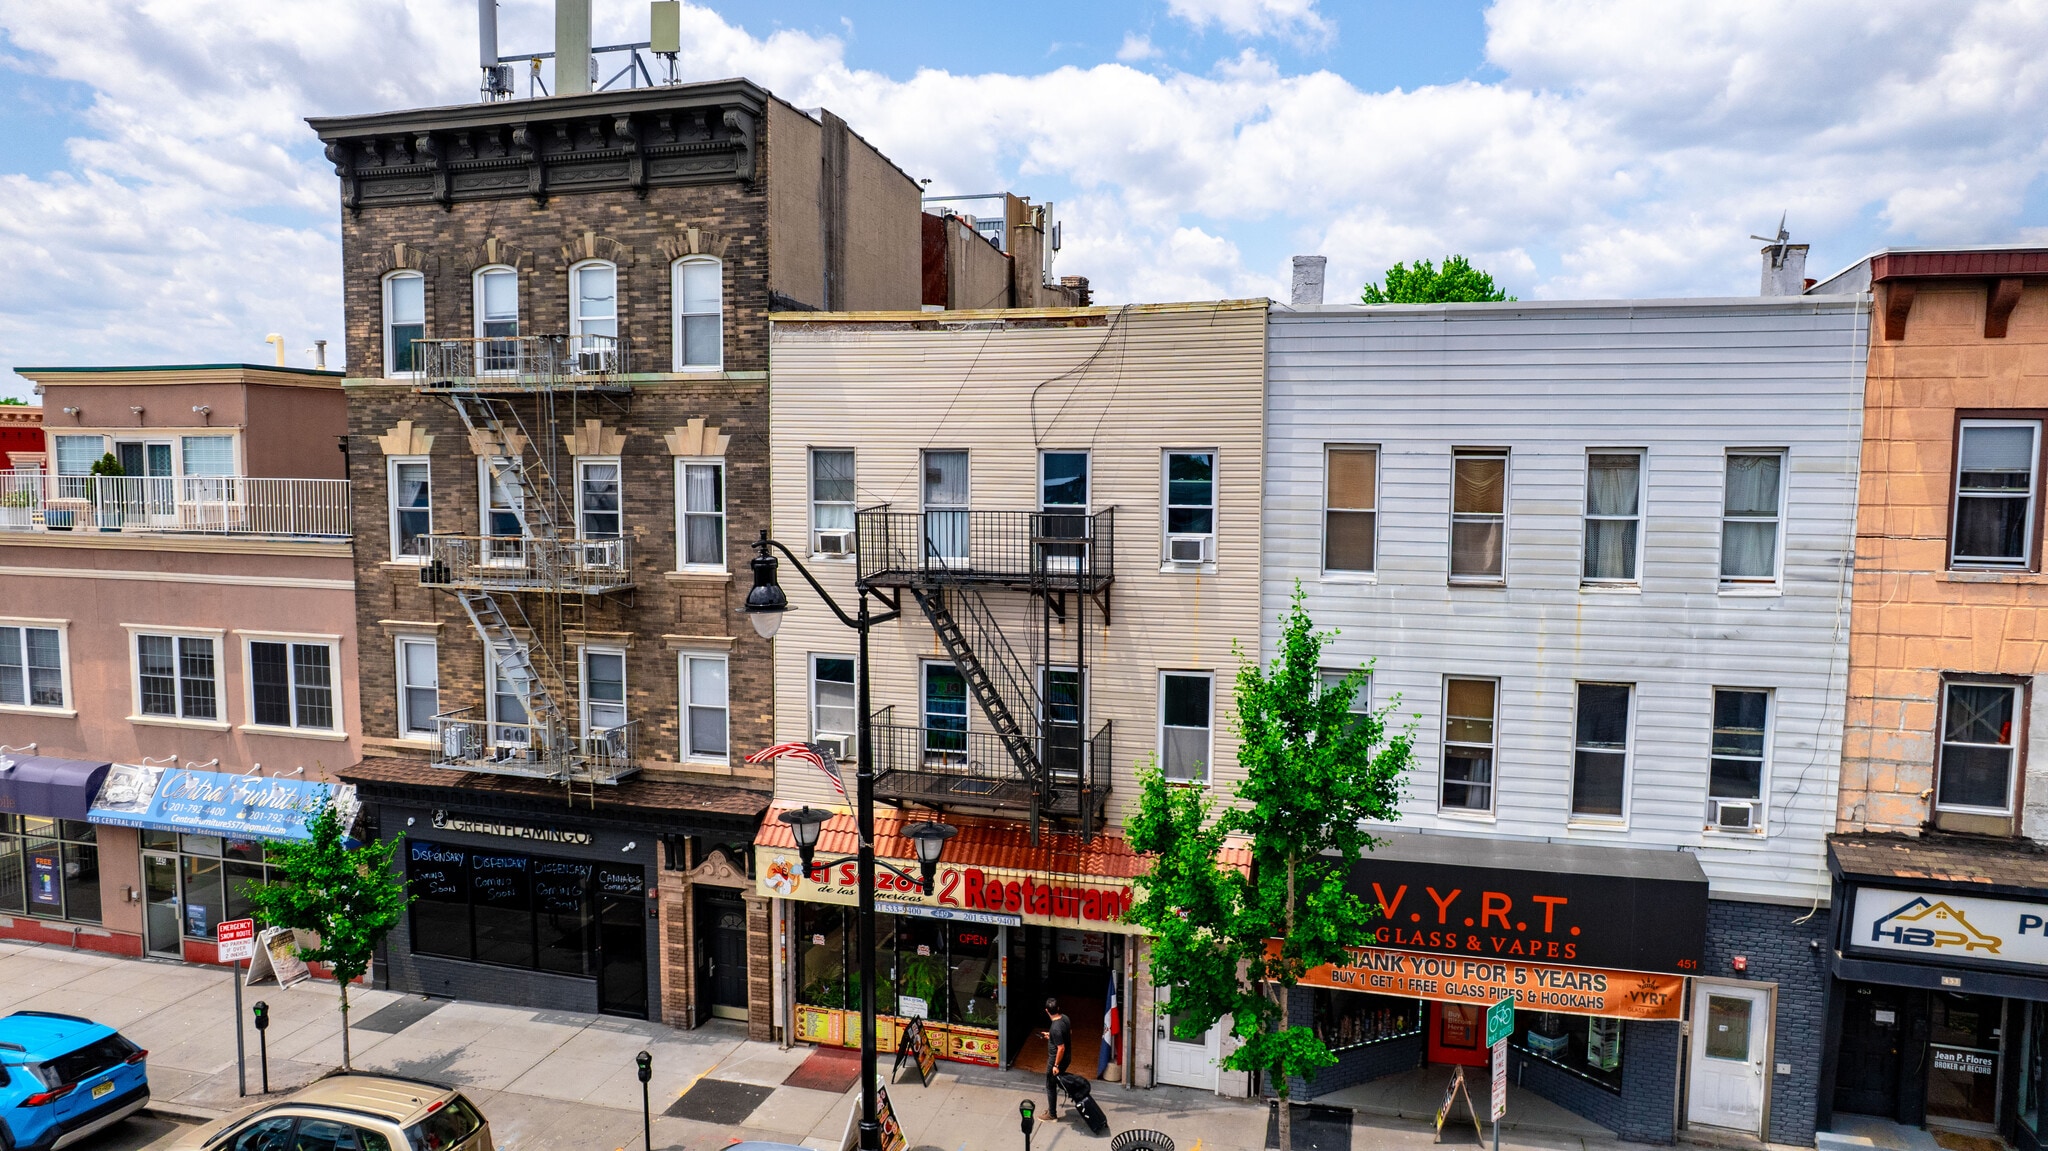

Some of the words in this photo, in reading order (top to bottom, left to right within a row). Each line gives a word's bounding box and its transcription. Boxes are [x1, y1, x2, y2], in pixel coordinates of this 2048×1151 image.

[161, 771, 234, 801] Central
[231, 776, 320, 812] Furniture
[168, 802, 226, 817] 201-792-4400
[88, 816, 99, 824] 445
[101, 817, 128, 827] CENTRAL
[131, 820, 145, 828] AVE.
[171, 814, 286, 835] CentralFurniture5577@gmail.com
[153, 823, 171, 832] Living
[172, 825, 191, 833] Rooms
[197, 827, 226, 837] Bedrooms
[453, 817, 500, 836] GREEN
[504, 824, 588, 844] FLAMINGO
[35, 857, 52, 866] FREE
[817, 885, 834, 893] de
[837, 887, 856, 896] las
[937, 867, 960, 907] 2
[964, 867, 1133, 922] Restaurant
[885, 904, 922, 915] 533-9400
[935, 910, 949, 918] 449
[963, 913, 977, 921] 201
[979, 915, 1016, 926] 533-9401
[1372, 882, 1581, 936] V.Y.R.T.
[220, 922, 251, 933] EMERGENCY
[220, 932, 235, 940] SNOW
[236, 930, 251, 938] ROUTE
[959, 933, 988, 946] OPEN
[1375, 927, 1457, 949] GLASS
[1466, 935, 1482, 951] &
[1491, 936, 1577, 960] VAPES
[1872, 921, 2002, 954] HBPR
[1346, 951, 1405, 973] HANK
[1410, 956, 1456, 978] YOU
[1463, 962, 1506, 983] FOR
[1514, 967, 1526, 985] 5
[1534, 968, 1608, 992] YEARS
[1676, 959, 1697, 970] 451
[1331, 970, 1356, 984] BUY
[1360, 973, 1365, 985] 1
[1370, 974, 1393, 988] GET
[1398, 978, 1403, 989] 1
[1408, 978, 1438, 993] FREE
[1445, 982, 1485, 998] GLASS
[1527, 990, 1537, 1003] &
[1541, 992, 1604, 1009] HOOKAHS
[1630, 991, 1668, 1005] VYRT
[1935, 1051, 1955, 1060] Jean
[1956, 1053, 1964, 1062] P.
[1966, 1055, 1992, 1066] Flores
[1934, 1061, 1958, 1070] BROKER
[1967, 1065, 1991, 1075] RECORD
